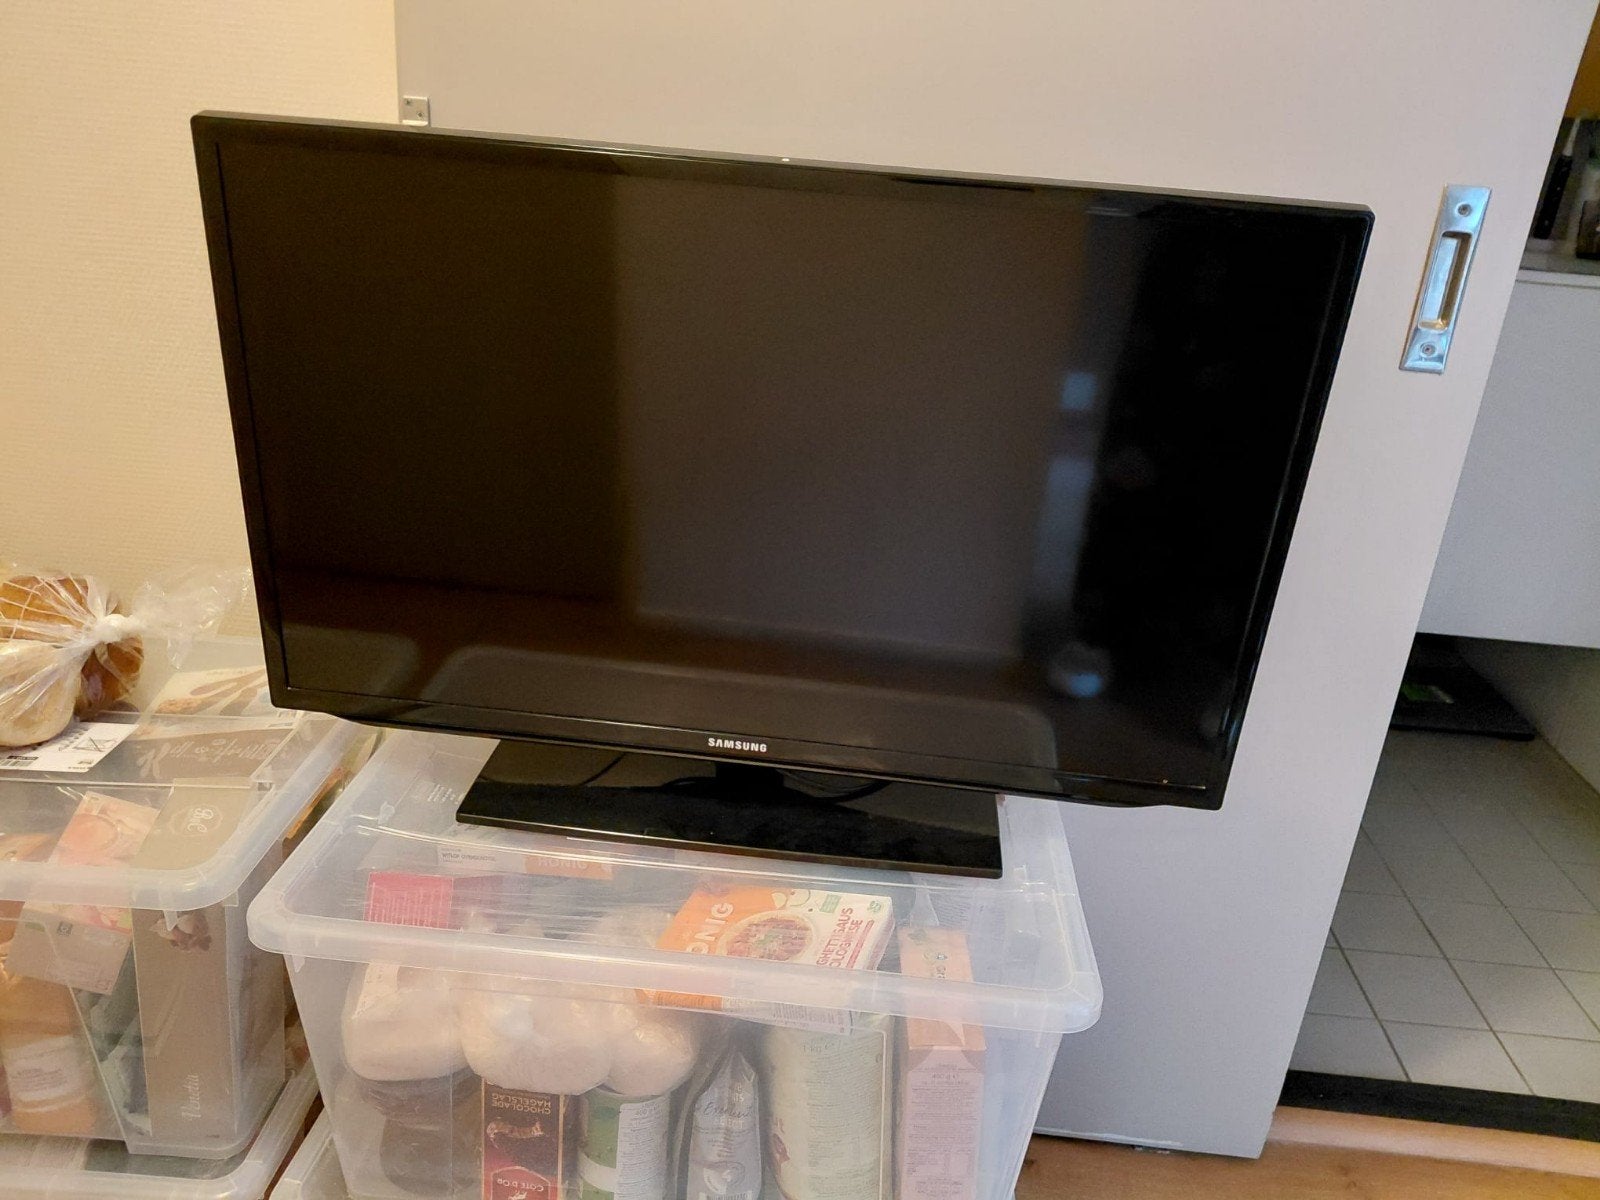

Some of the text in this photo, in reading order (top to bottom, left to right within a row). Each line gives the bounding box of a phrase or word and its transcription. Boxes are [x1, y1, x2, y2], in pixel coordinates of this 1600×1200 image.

[708, 737, 767, 752] SAMSUNG
[685, 902, 734, 954] ONIG
[816, 907, 855, 967] GHETTISAUS
[491, 1092, 552, 1109] HAGELSLAG
[491, 1100, 552, 1115] CHOCOLADE
